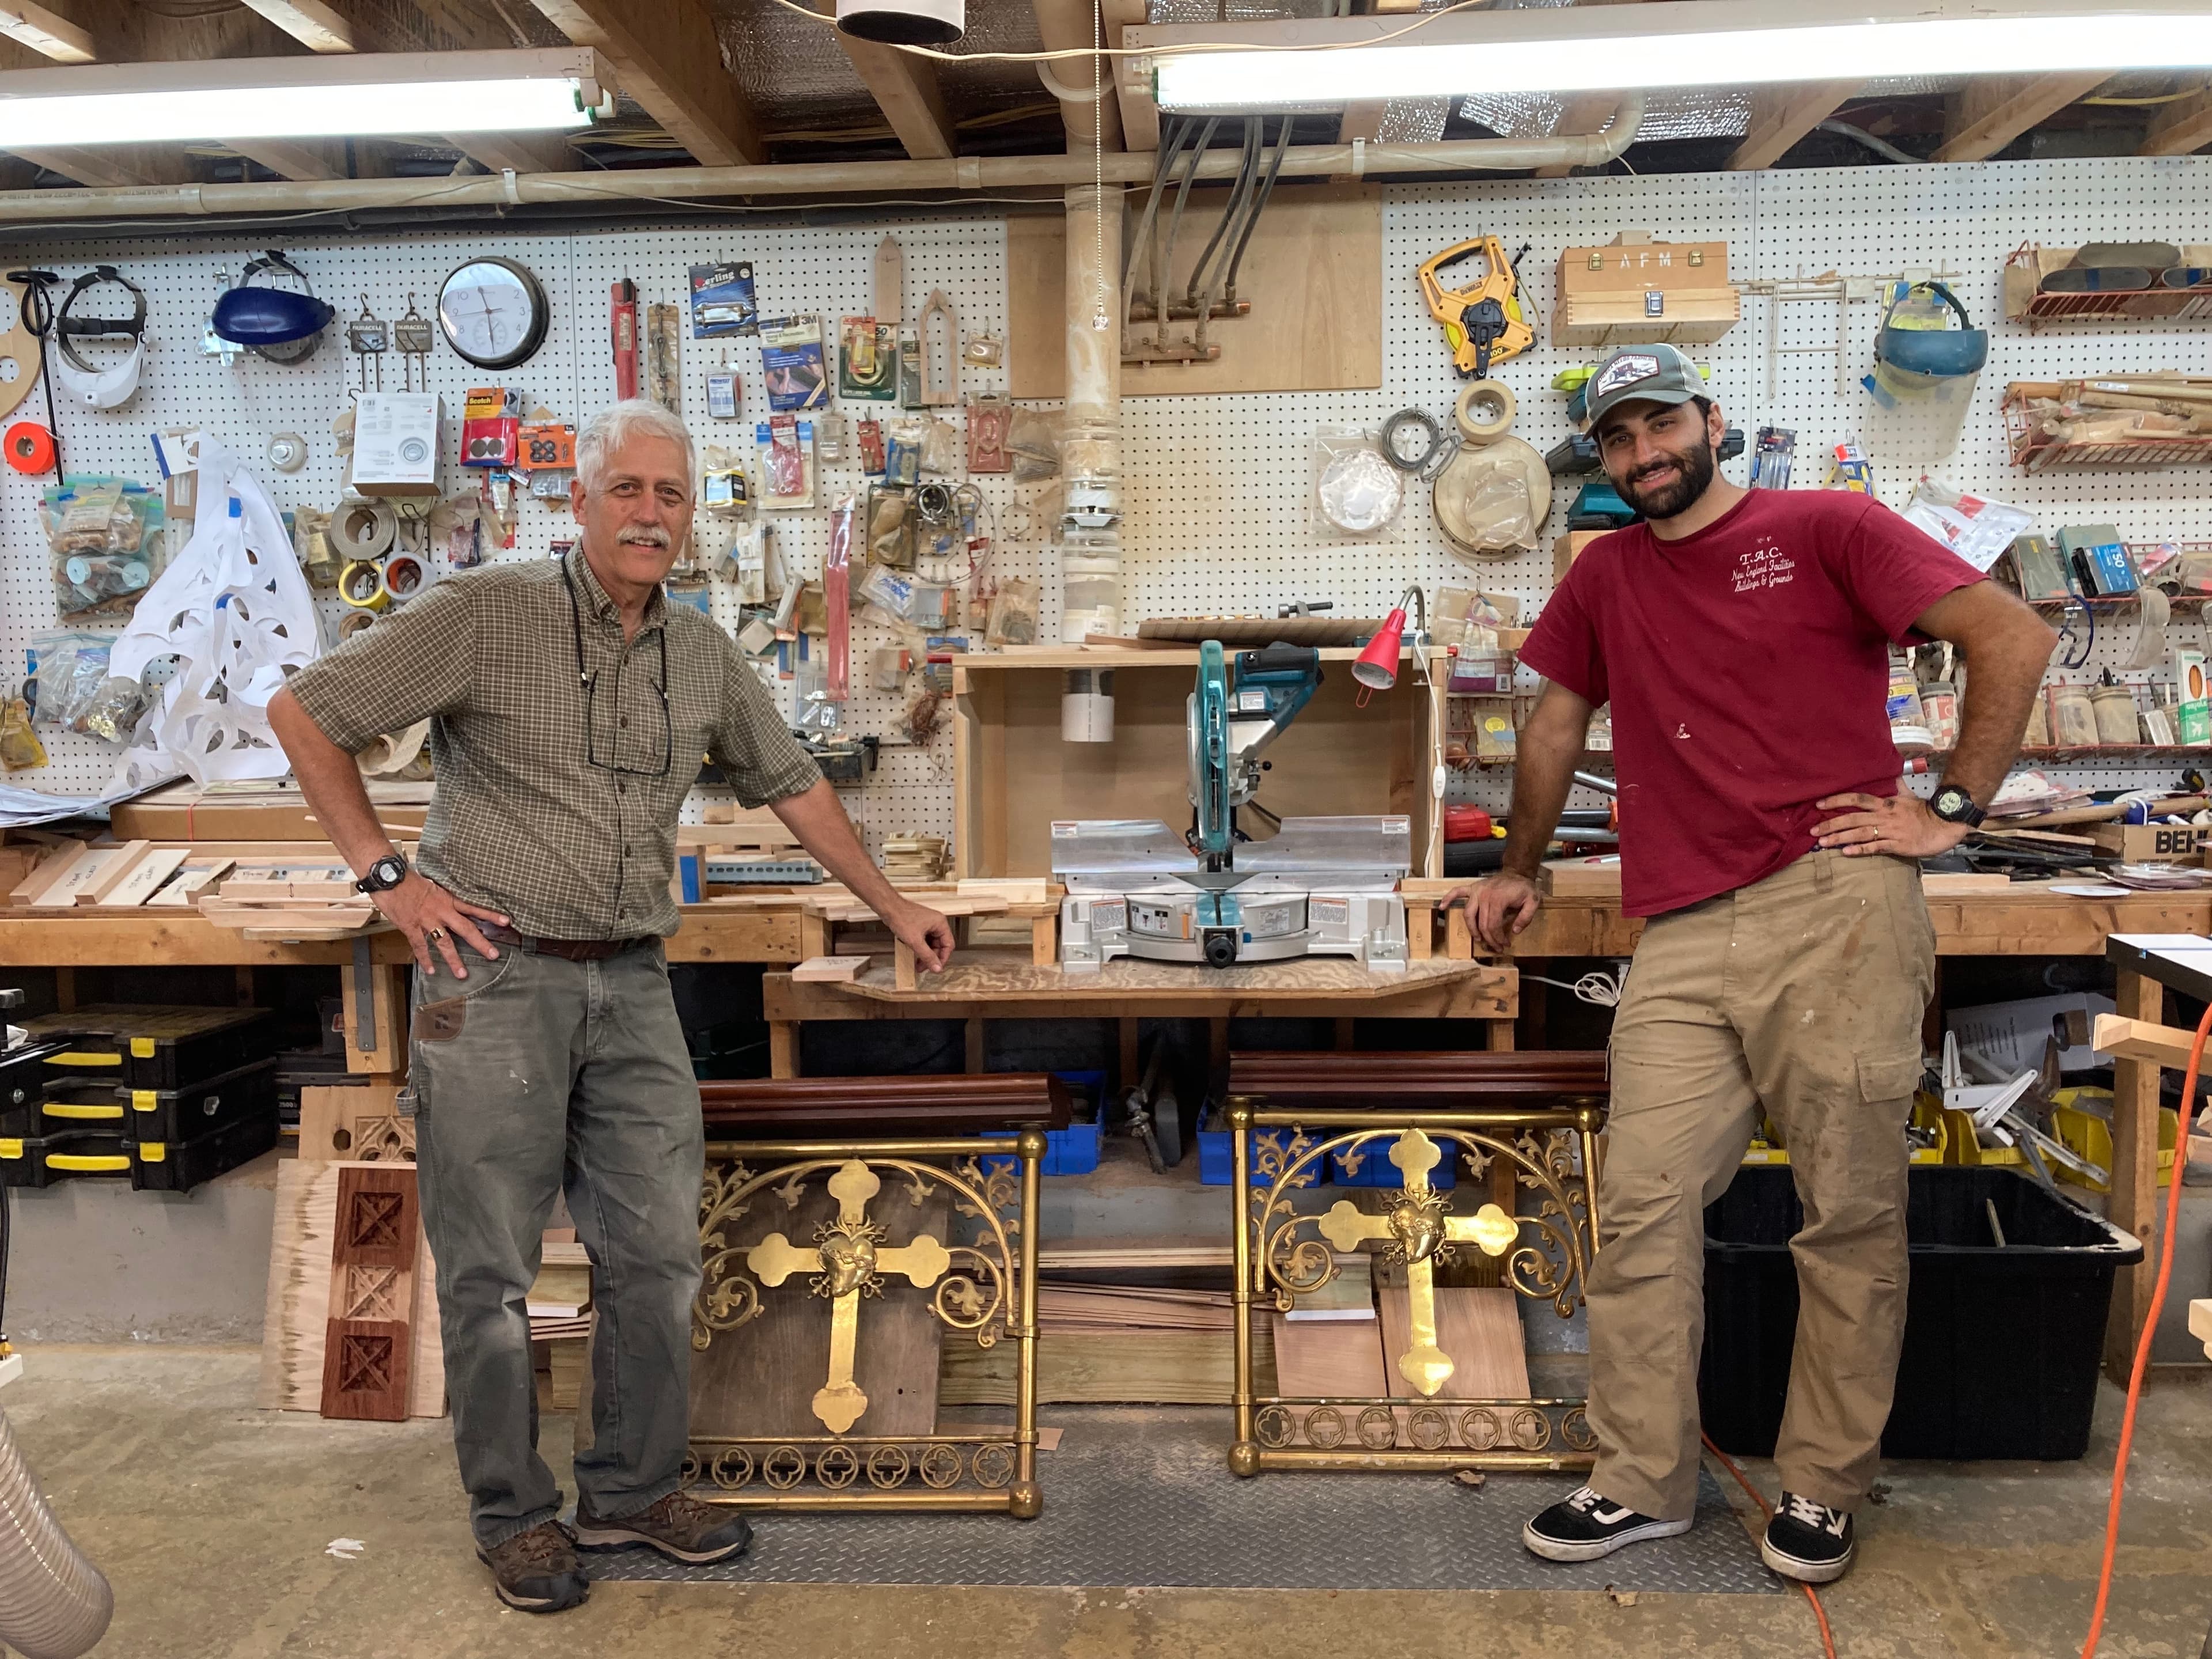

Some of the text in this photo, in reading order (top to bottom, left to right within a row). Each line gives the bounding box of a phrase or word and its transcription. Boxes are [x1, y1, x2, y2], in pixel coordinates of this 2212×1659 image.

[1620, 251, 1671, 268] A F M
[801, 316, 817, 324] 3M
[1740, 547, 1783, 565] T.A.C.
[1731, 558, 1795, 581] New England Facilities
[1734, 570, 1793, 592] Buildings & Grounds
